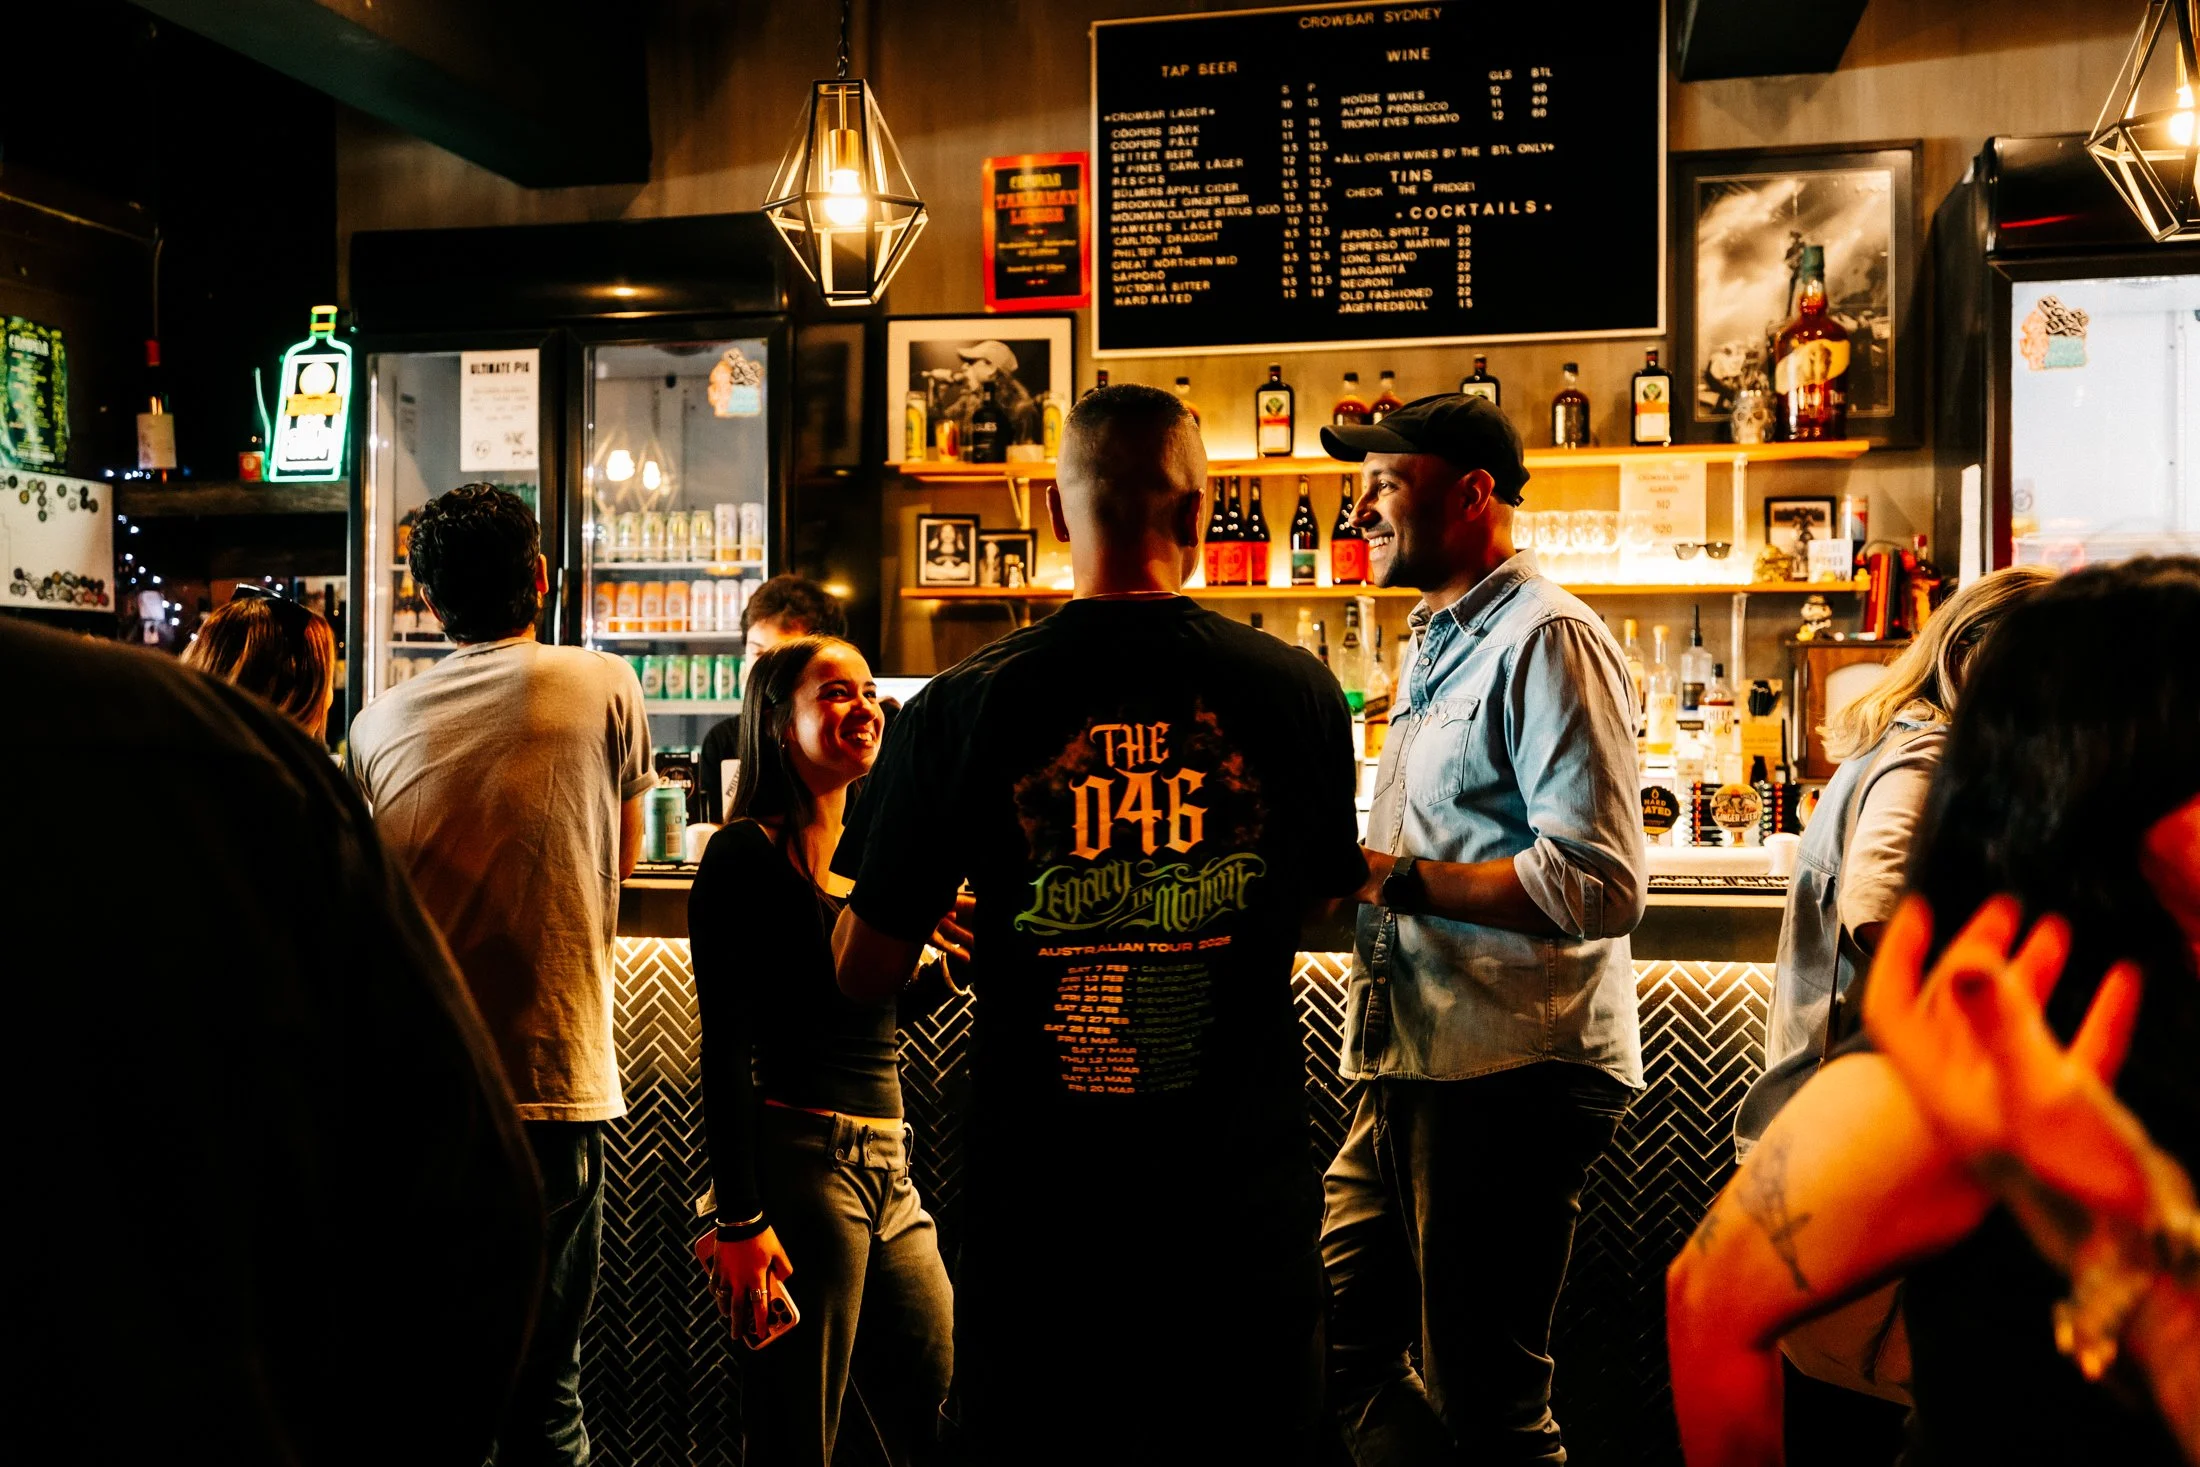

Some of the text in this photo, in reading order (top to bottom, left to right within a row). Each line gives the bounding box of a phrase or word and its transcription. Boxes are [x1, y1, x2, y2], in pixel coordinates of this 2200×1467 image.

[1299, 7, 1442, 28] CROWBAR SYDNEY
[1386, 47, 1431, 62] WINE
[1161, 61, 1237, 78] TAP BEER
[1488, 69, 1513, 81] GLS
[1340, 93, 1380, 105] HOUSE
[1386, 90, 1425, 102] WINES
[1111, 107, 1208, 122] CROWBAR LAGER
[1387, 101, 1449, 114] PROSECCO
[1341, 118, 1380, 129] TROPHY
[1382, 116, 1409, 127] EYES
[1414, 112, 1460, 125] ROSATO
[1111, 124, 1200, 138] COOPERS DARK
[1110, 139, 1162, 150] COOPERS
[1168, 136, 1199, 147] PALE
[1111, 149, 1194, 163] BETTER BEER
[1342, 143, 1548, 164] ALL OTHER WINES BY THE BTL ONLY
[1126, 163, 1162, 173] PINES
[1168, 160, 1200, 171] DARK
[1205, 158, 1244, 169] LAGER
[1111, 175, 1166, 186] RESCHS
[1390, 168, 1434, 183] TINS
[1112, 182, 1239, 199] BULMERS APPLE CIDER
[1345, 187, 1384, 197] CHECK
[1398, 184, 1418, 195] THE
[1112, 194, 1249, 210] BROOKVALE GINGER BEER
[1409, 199, 1537, 219] COCKTAILS
[1111, 204, 1281, 223] MOUNTAIN CULTURE STATUS QUO
[1111, 222, 1172, 234] HAWKERS
[1181, 219, 1223, 231] LAGER
[1341, 228, 1384, 240] APEROL
[1388, 226, 1429, 237] SPRITZ
[1113, 231, 1219, 246] CARLTON DRAUGHT
[1340, 240, 1398, 252] ESPRESSO
[1405, 237, 1450, 249] MARTINI
[1113, 247, 1156, 258] PHILTER
[1341, 254, 1371, 264] LONG
[1376, 251, 1417, 263] ISLAND
[1111, 255, 1238, 270] GREAT NORTHERN MID
[1340, 263, 1406, 276] MARGARITA
[1112, 270, 1166, 282] SAPPORO
[1340, 278, 1393, 288] NEGRONI
[1113, 280, 1211, 294] VICTORIA BITTER
[1113, 293, 1193, 306] HARD RATED
[1339, 290, 1365, 301] OLD
[1368, 288, 1433, 300] FASHIONED
[1338, 299, 1429, 314] JAGER REDBULL
[470, 362, 510, 375] ULTIMATE
[1090, 721, 1171, 770] THE
[1068, 767, 1209, 861] 046
[1715, 813, 1740, 823] GINGER
[1038, 942, 1144, 957] AUSTRALIAN
[1148, 942, 1193, 952] TOUR
[1067, 966, 1091, 974] SAT
[1106, 964, 1129, 972] FEB
[1057, 985, 1080, 993] SAT
[1101, 985, 1123, 993] FEB
[1096, 1006, 1119, 1014] FEB
[1087, 1026, 1111, 1034] FEB
[1057, 1035, 1077, 1043] FRI
[1071, 1046, 1094, 1054] SAT
[1112, 1066, 1140, 1074] MAR
[1068, 1084, 1086, 1092] FRI
[1107, 1086, 1135, 1094] MAR
